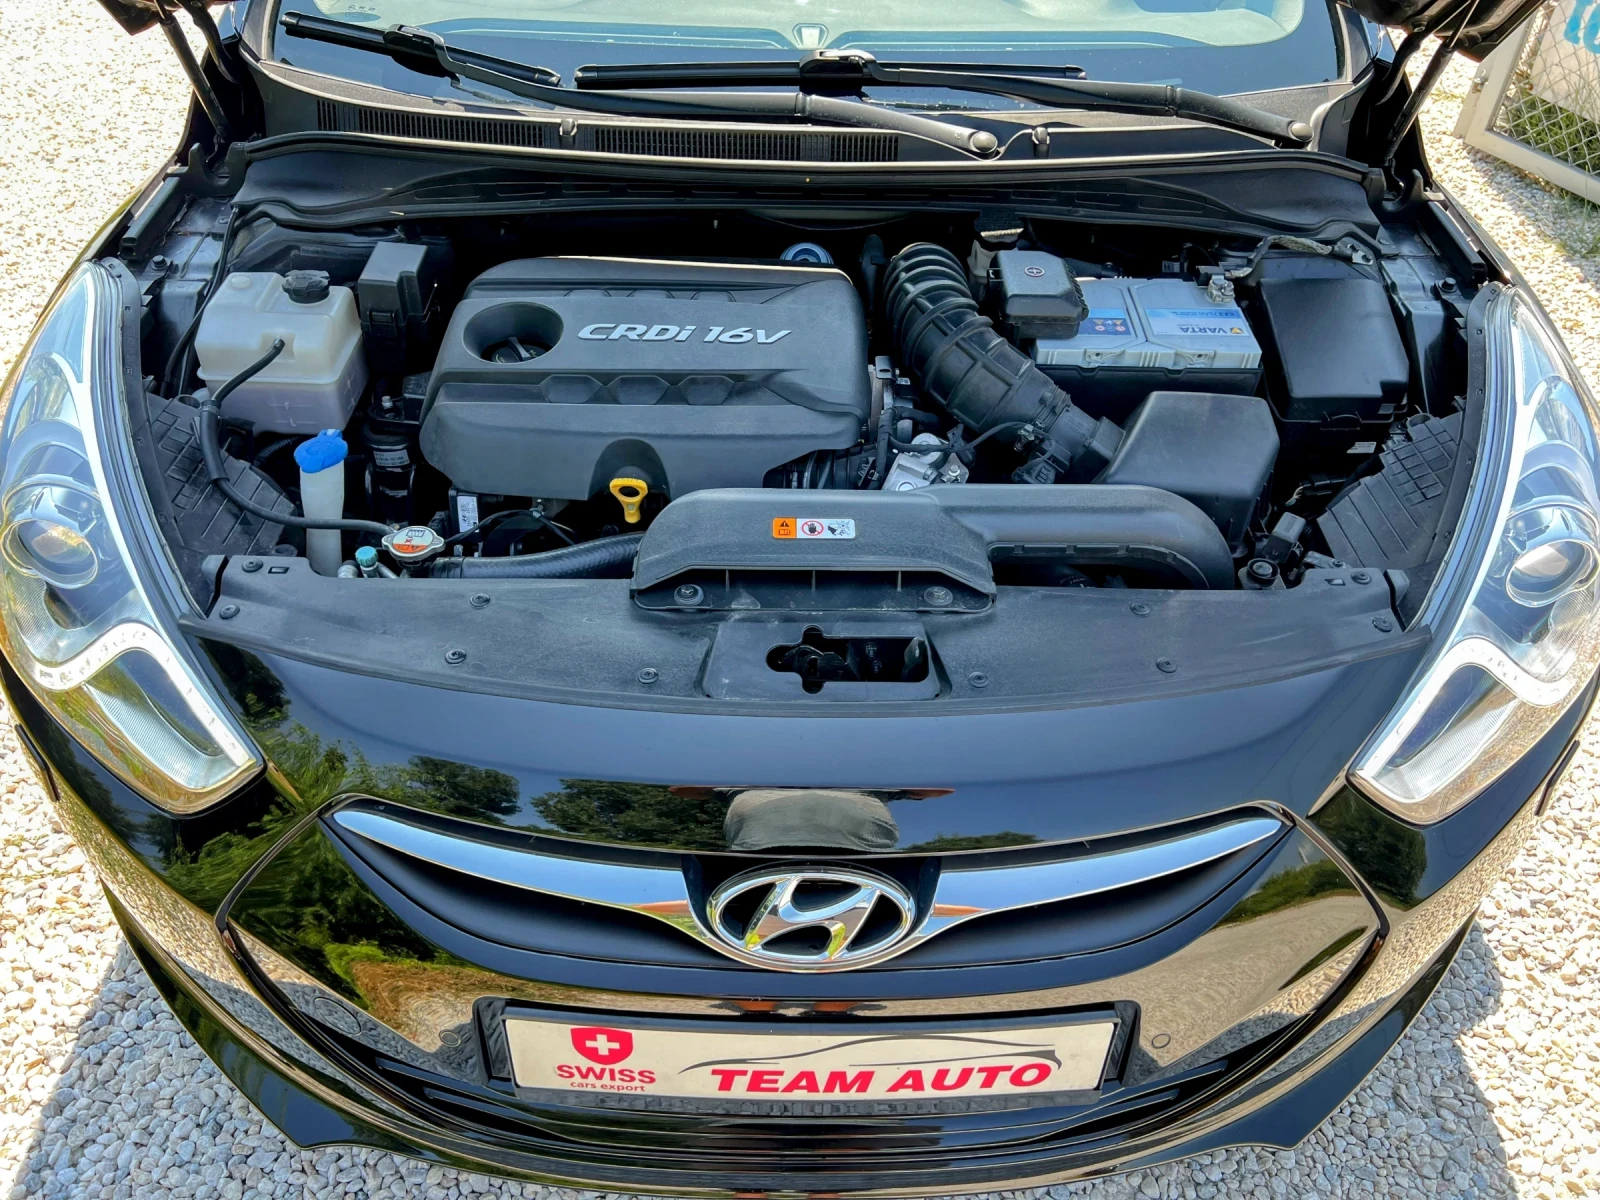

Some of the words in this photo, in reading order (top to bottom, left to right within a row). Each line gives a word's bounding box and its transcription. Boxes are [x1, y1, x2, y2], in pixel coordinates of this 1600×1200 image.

[578, 323, 697, 342] CRDi
[703, 326, 792, 344] 16V
[557, 1064, 656, 1084] SWISS
[711, 1069, 875, 1093] TEAM
[886, 1063, 1052, 1093] AUTO
[570, 1081, 597, 1089] cars
[600, 1083, 646, 1092] export
